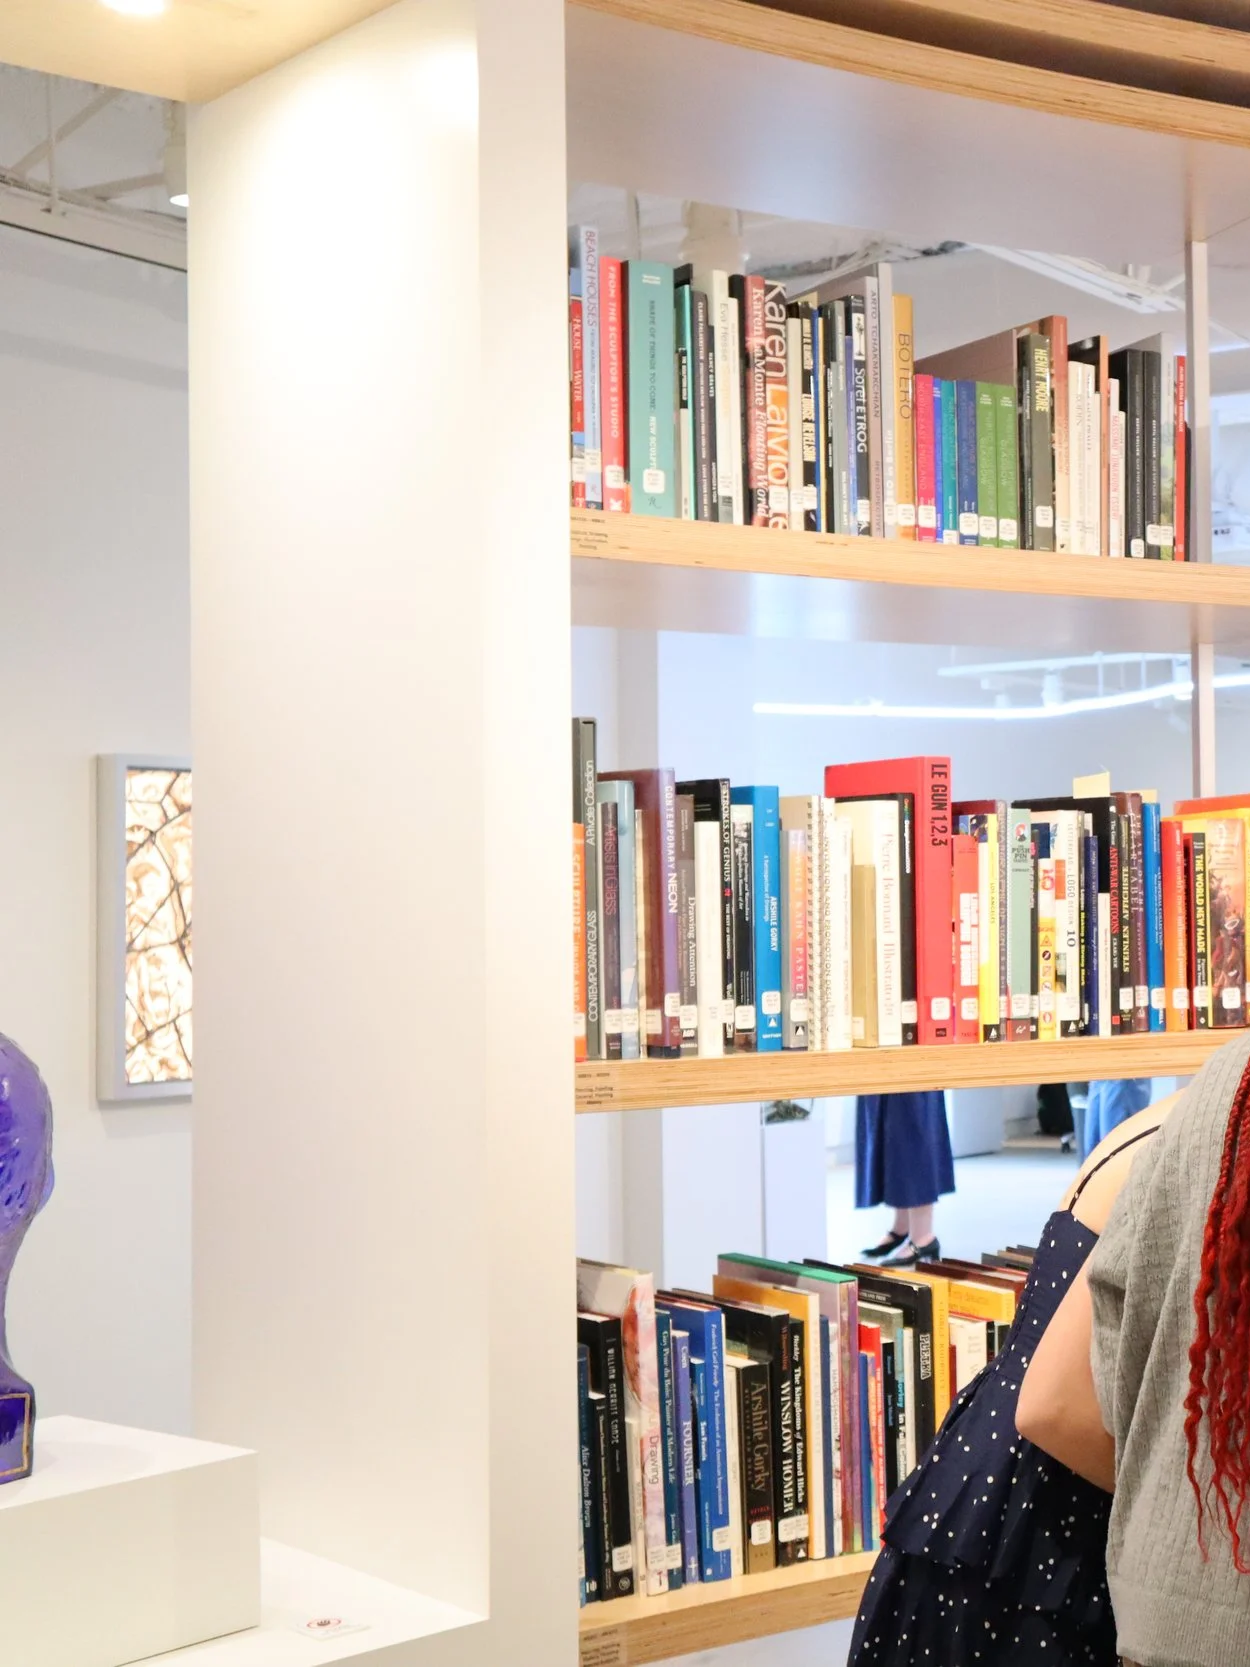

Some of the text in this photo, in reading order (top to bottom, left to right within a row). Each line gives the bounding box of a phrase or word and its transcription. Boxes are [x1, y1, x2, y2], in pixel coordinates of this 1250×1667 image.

[585, 230, 598, 326] BEACH HOUSES
[608, 266, 620, 438] FROM THE SCULPTOR'S STUDIO
[649, 327, 656, 336] OF
[719, 303, 730, 361] Eva Hesse
[870, 290, 881, 418] ARTO TCHAKMAKCHIAN
[573, 319, 583, 401] HOUSE WATER
[649, 373, 656, 383] TO
[899, 333, 913, 419] BOTERO
[1034, 348, 1049, 413] HENRY MOORE
[649, 417, 657, 434] NEW
[752, 287, 769, 517] Karen LaMonte Floating World
[764, 279, 790, 530] Karen LaMote
[802, 394, 816, 462] LOUISE NEVELSON
[856, 406, 867, 453] ETROG
[584, 760, 595, 837] Private Collection
[930, 763, 948, 847] LE GUN 1,2,3
[664, 785, 678, 913] CONTEMPORARY NEON
[722, 788, 731, 881] STROKES OF GENIUS
[604, 824, 618, 915] Artists in Glass
[881, 834, 895, 934] Pierre Bonnard
[1067, 874, 1076, 898] LOGO
[1109, 847, 1118, 888] ANTI-WAR
[1130, 866, 1139, 913] LABEL
[1138, 870, 1142, 883] OF
[795, 901, 804, 940] KAHN
[1110, 890, 1120, 934] CARTOONS
[1195, 854, 1206, 953] THE WORLD NEW MADE
[687, 897, 697, 987] Drawing Attention
[770, 928, 778, 951] GORKY
[1067, 930, 1076, 947] 10
[1122, 925, 1130, 972] STEINLEN
[1177, 916, 1185, 956] influential
[587, 911, 598, 1022] CONTEMPORARY GLASS
[660, 1331, 669, 1346] Guy
[711, 1351, 719, 1364] Carl
[920, 1334, 931, 1380] PLETKA
[607, 1348, 618, 1415] WILLIAM MERRITT
[663, 1367, 670, 1378] du
[794, 1367, 802, 1386] The
[896, 1374, 906, 1408] Morley
[664, 1399, 672, 1425] Painter
[666, 1427, 673, 1436] of
[714, 1403, 722, 1432] Evolution
[751, 1382, 769, 1442] Arshile
[781, 1380, 793, 1453] WINSLOW
[794, 1386, 804, 1431] Kingdoms
[898, 1413, 906, 1423] in
[682, 1422, 694, 1486] FOURNIER
[700, 1437, 708, 1461] Francis
[796, 1441, 805, 1476] Edward
[898, 1426, 906, 1445] Full
[648, 1436, 661, 1485] Drawing
[668, 1469, 676, 1484] Life
[716, 1448, 724, 1476] American
[751, 1444, 770, 1492] Gorky
[581, 1445, 592, 1528] Alice Dalton Brown
[782, 1459, 794, 1513] HOMER
[797, 1477, 805, 1503] Hicks
